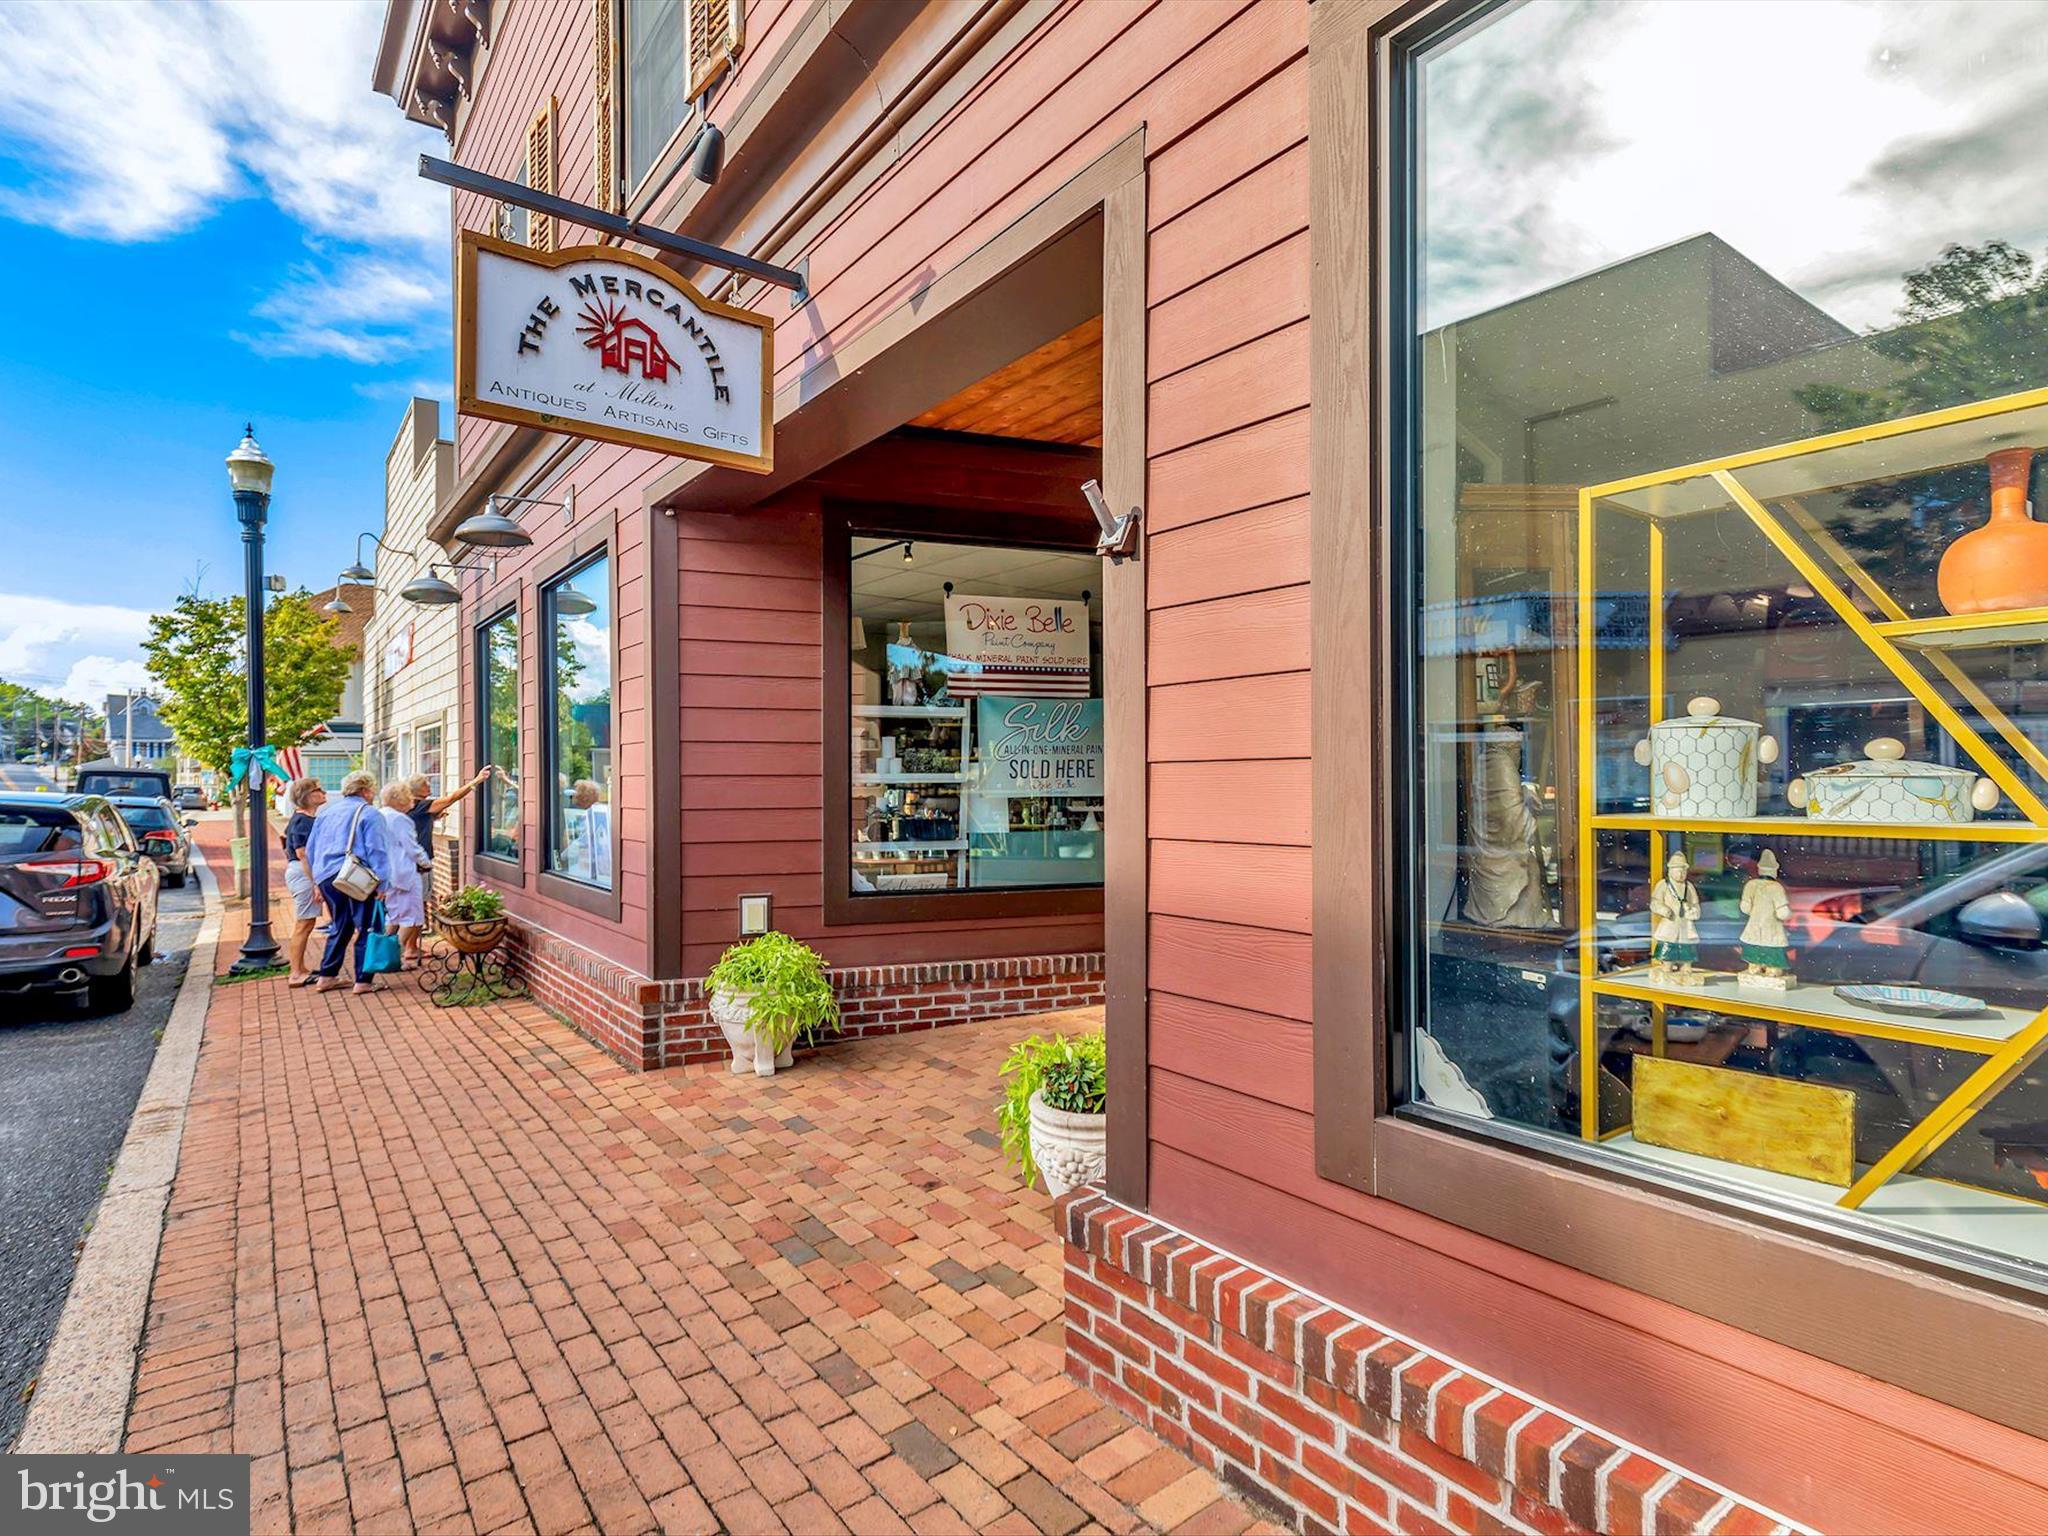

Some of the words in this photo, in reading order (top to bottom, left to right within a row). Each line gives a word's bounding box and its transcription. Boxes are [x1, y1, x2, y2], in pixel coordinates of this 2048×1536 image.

[517, 295, 560, 354] THE
[569, 273, 730, 405] MERCANTILE
[573, 381, 597, 393] at
[604, 380, 677, 411] Milton
[489, 380, 588, 412] ANTIQUES
[603, 404, 690, 434] ARTISANS
[702, 425, 750, 446] GIFTS
[959, 602, 1018, 631] Dixie
[1024, 604, 1076, 634] Belle
[981, 631, 1010, 647] Paint
[1011, 633, 1057, 655] Company
[975, 654, 1013, 664] MINERAL
[1015, 655, 1041, 665] PAINT
[1042, 655, 1065, 665] SOLD
[1066, 656, 1089, 666] HERE
[992, 701, 1089, 762] Silk
[1085, 744, 1104, 755] PAIN
[1008, 759, 1051, 779] SOLD
[1055, 759, 1096, 779] HERE
